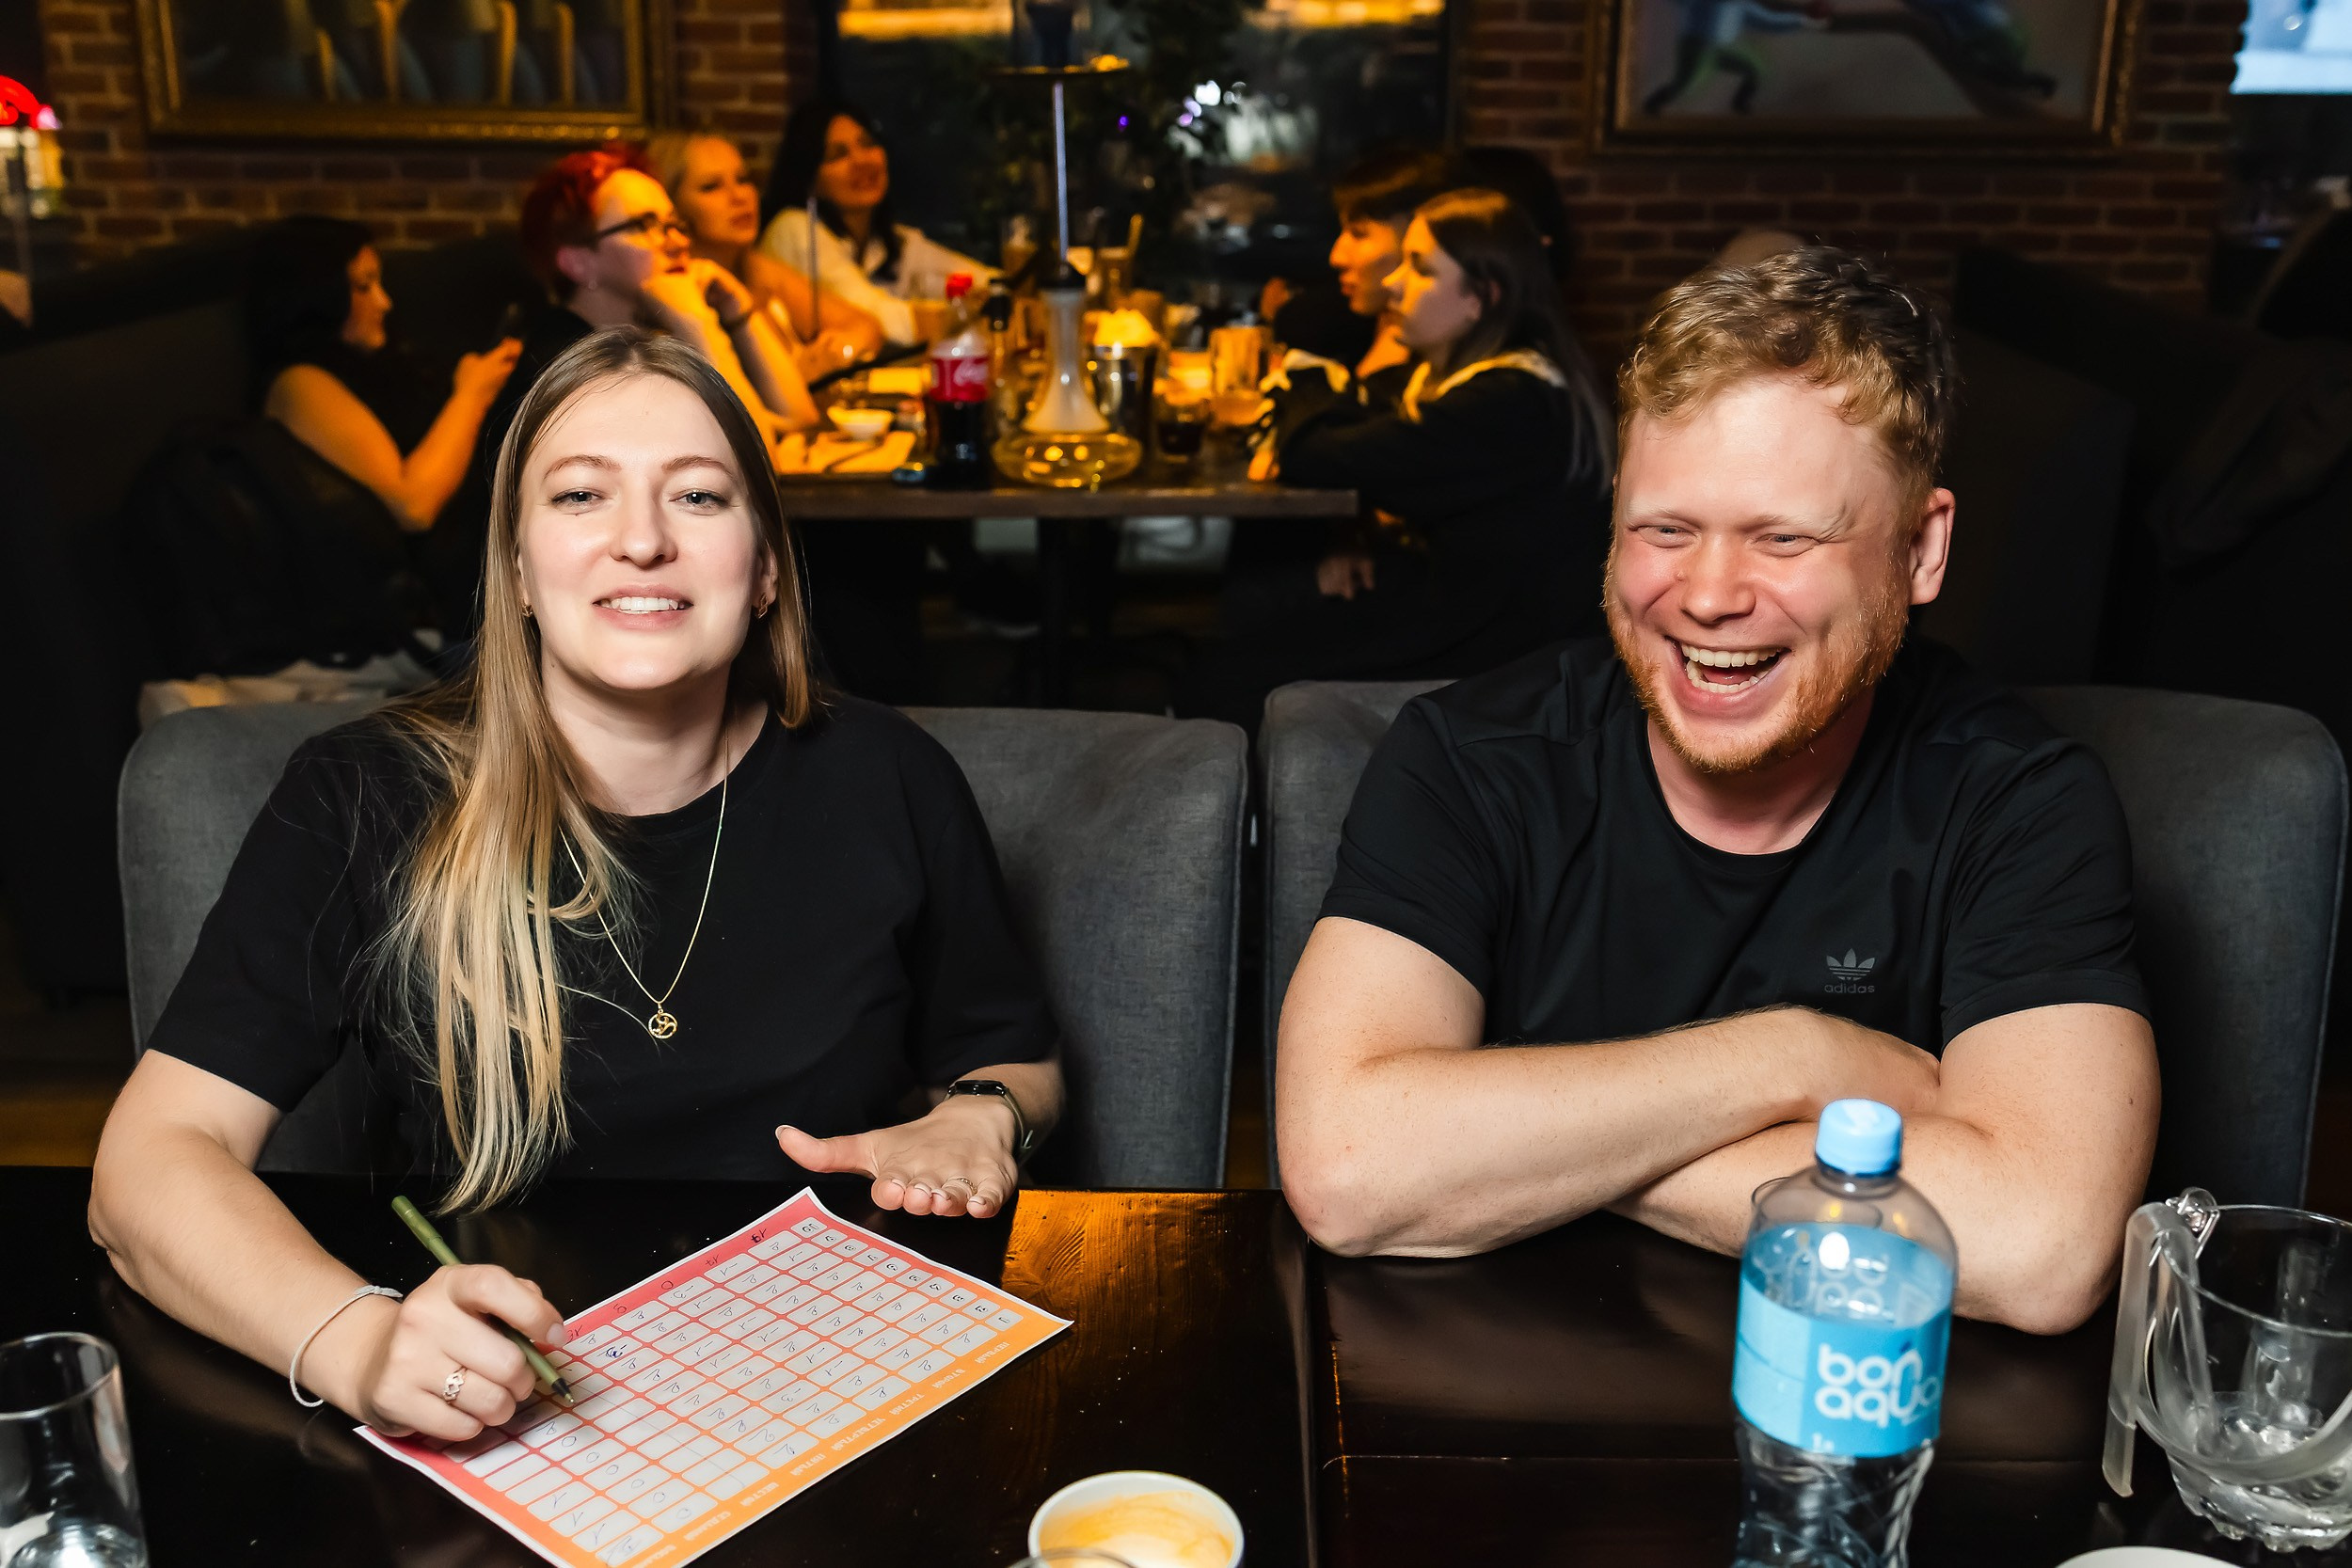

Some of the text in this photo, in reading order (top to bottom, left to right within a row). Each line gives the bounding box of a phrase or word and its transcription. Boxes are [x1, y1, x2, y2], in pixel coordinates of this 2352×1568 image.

[1824, 983, 1875, 994] adidas
[802, 1223, 819, 1233] 10
[975, 1305, 988, 1313] 2
[974, 1341, 1009, 1363] ПЕРВЫЙ
[1818, 1343, 1923, 1387] bon
[930, 1368, 965, 1388] ВТОРОЙ
[888, 1393, 925, 1415] ТРЕТИЙ
[830, 1418, 885, 1450] ЧЕТВЕРТЫЙ
[789, 1452, 825, 1476] ПЯТЫЙ
